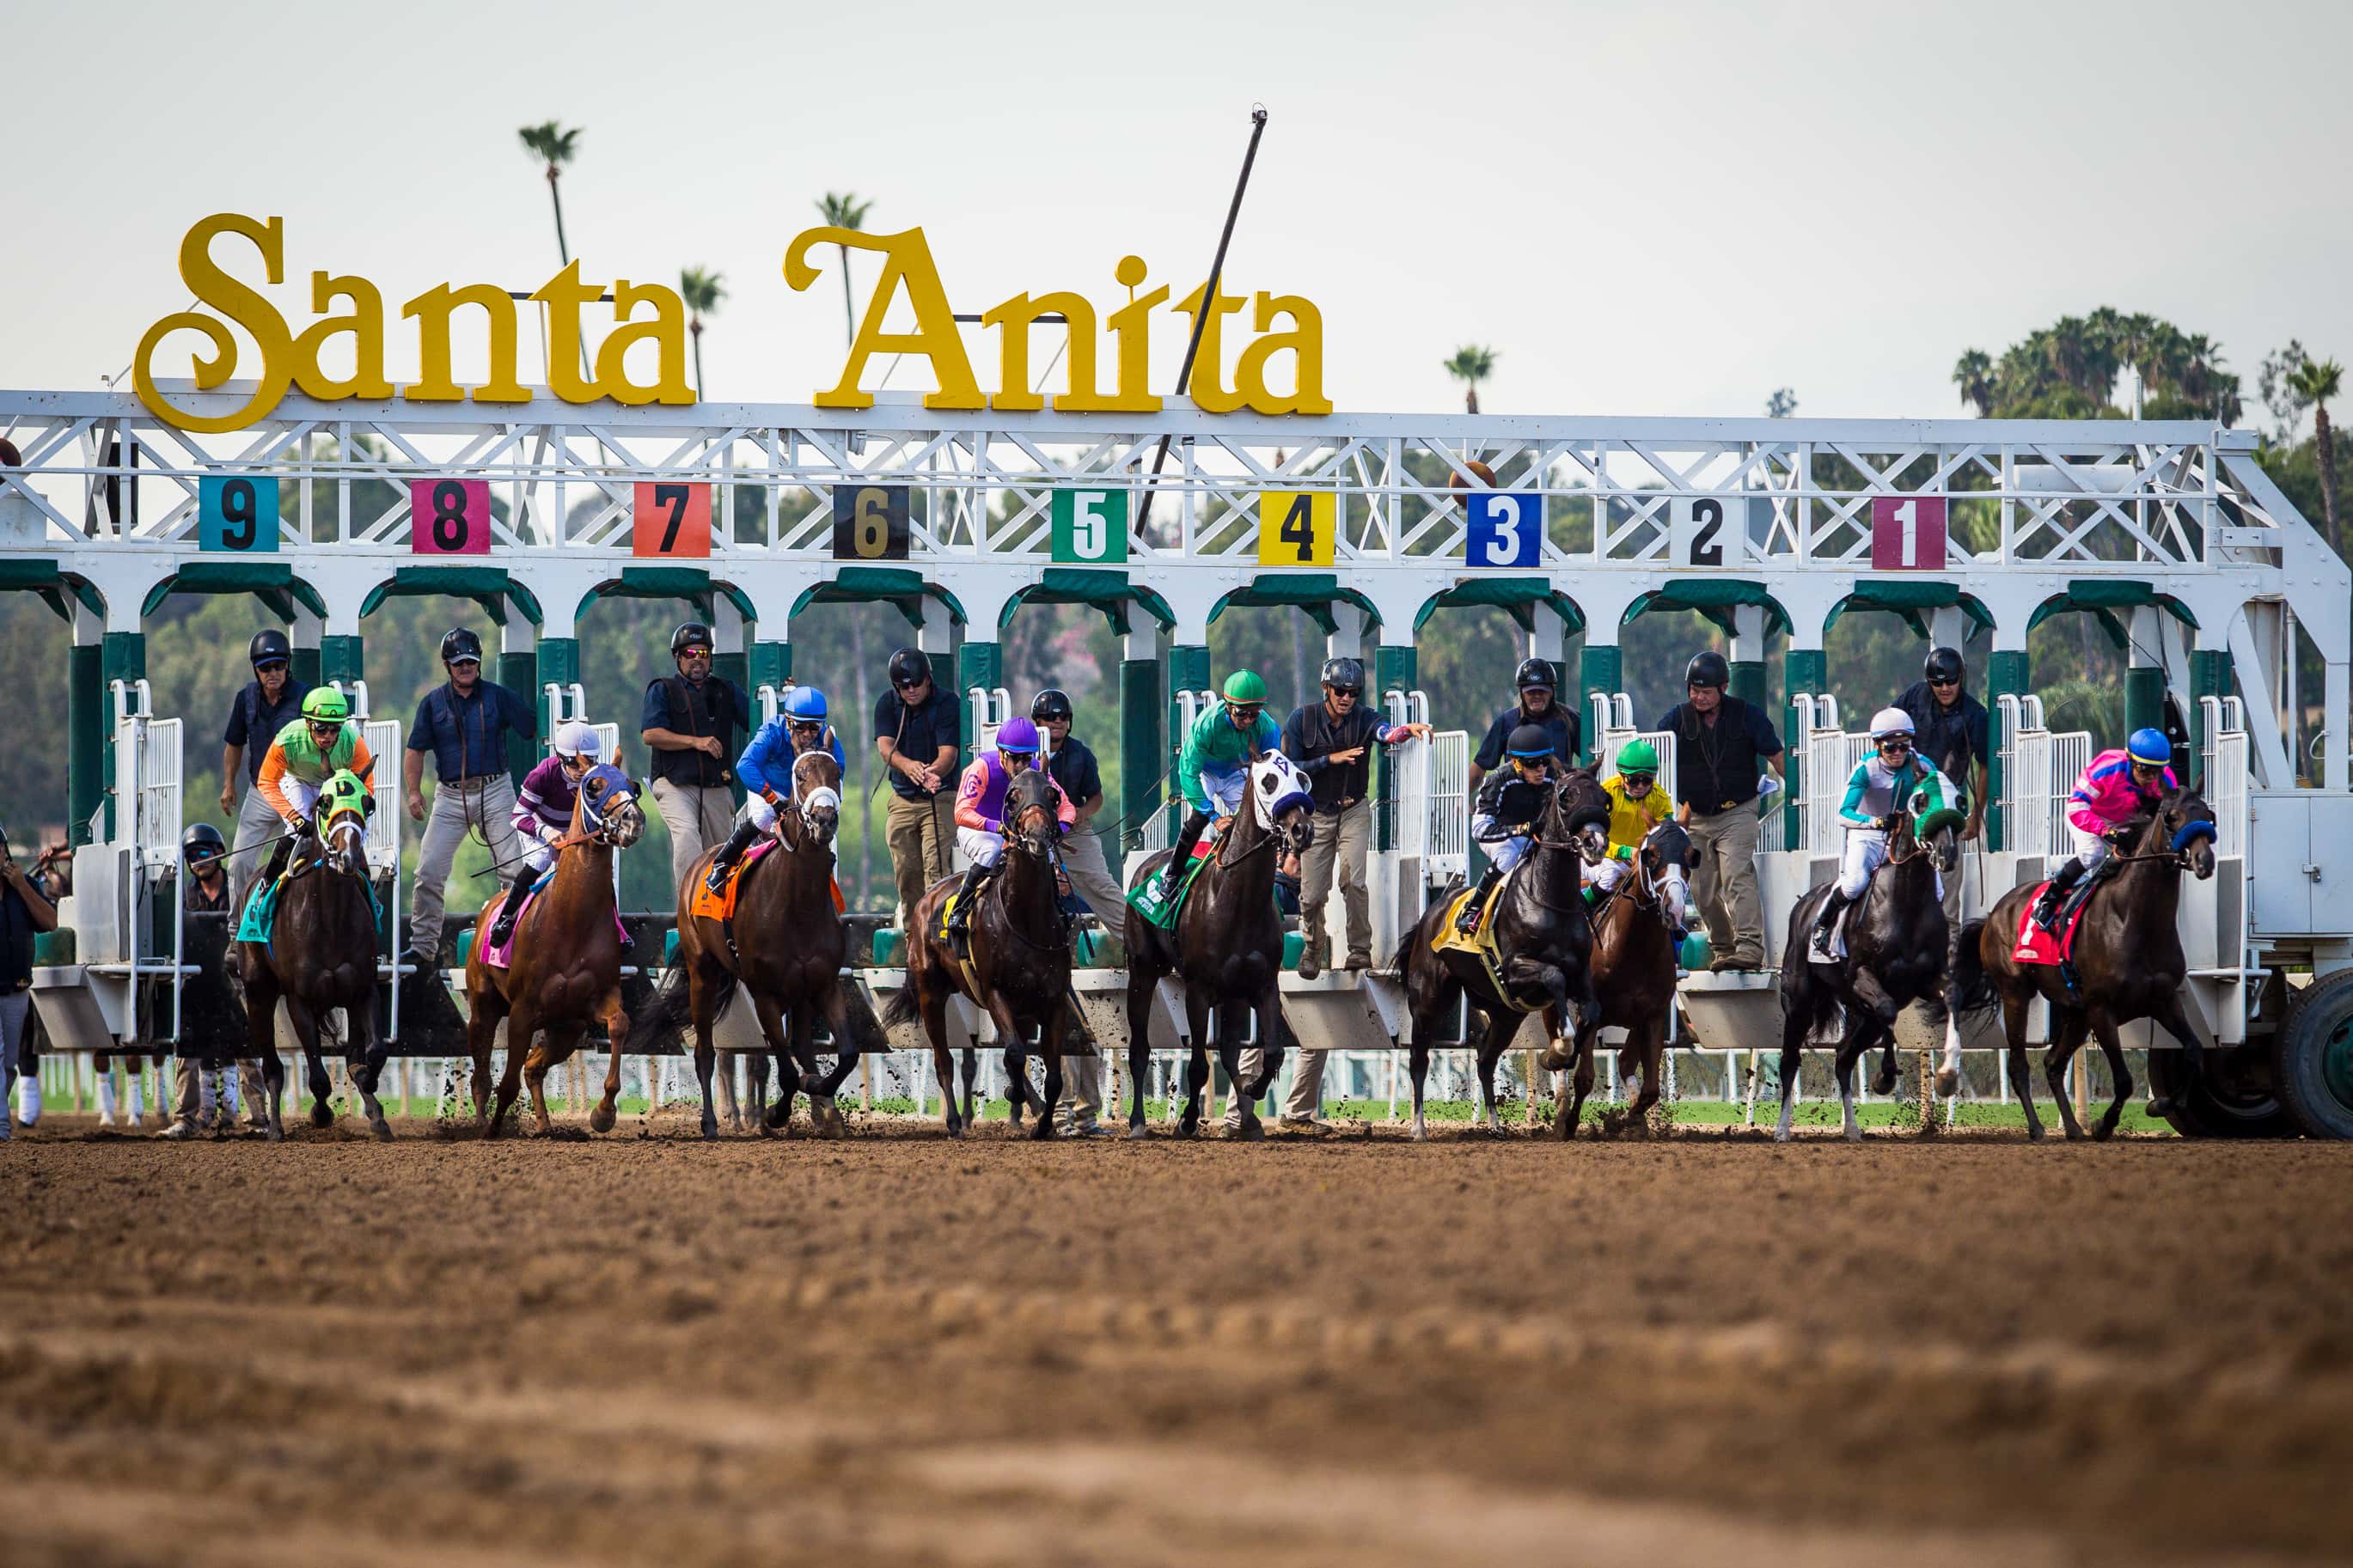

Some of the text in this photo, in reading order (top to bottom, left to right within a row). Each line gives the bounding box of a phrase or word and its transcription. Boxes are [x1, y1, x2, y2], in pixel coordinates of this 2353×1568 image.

[132, 212, 1334, 434] Santa Anita
[221, 479, 257, 551] 9
[432, 481, 468, 551] 8
[655, 484, 690, 552] 7
[854, 487, 889, 559] 6
[1073, 492, 1107, 559] 5
[1280, 494, 1315, 561] 4
[1487, 496, 1520, 565] 3
[1690, 497, 1723, 566] 2
[1892, 500, 1918, 567] 1
